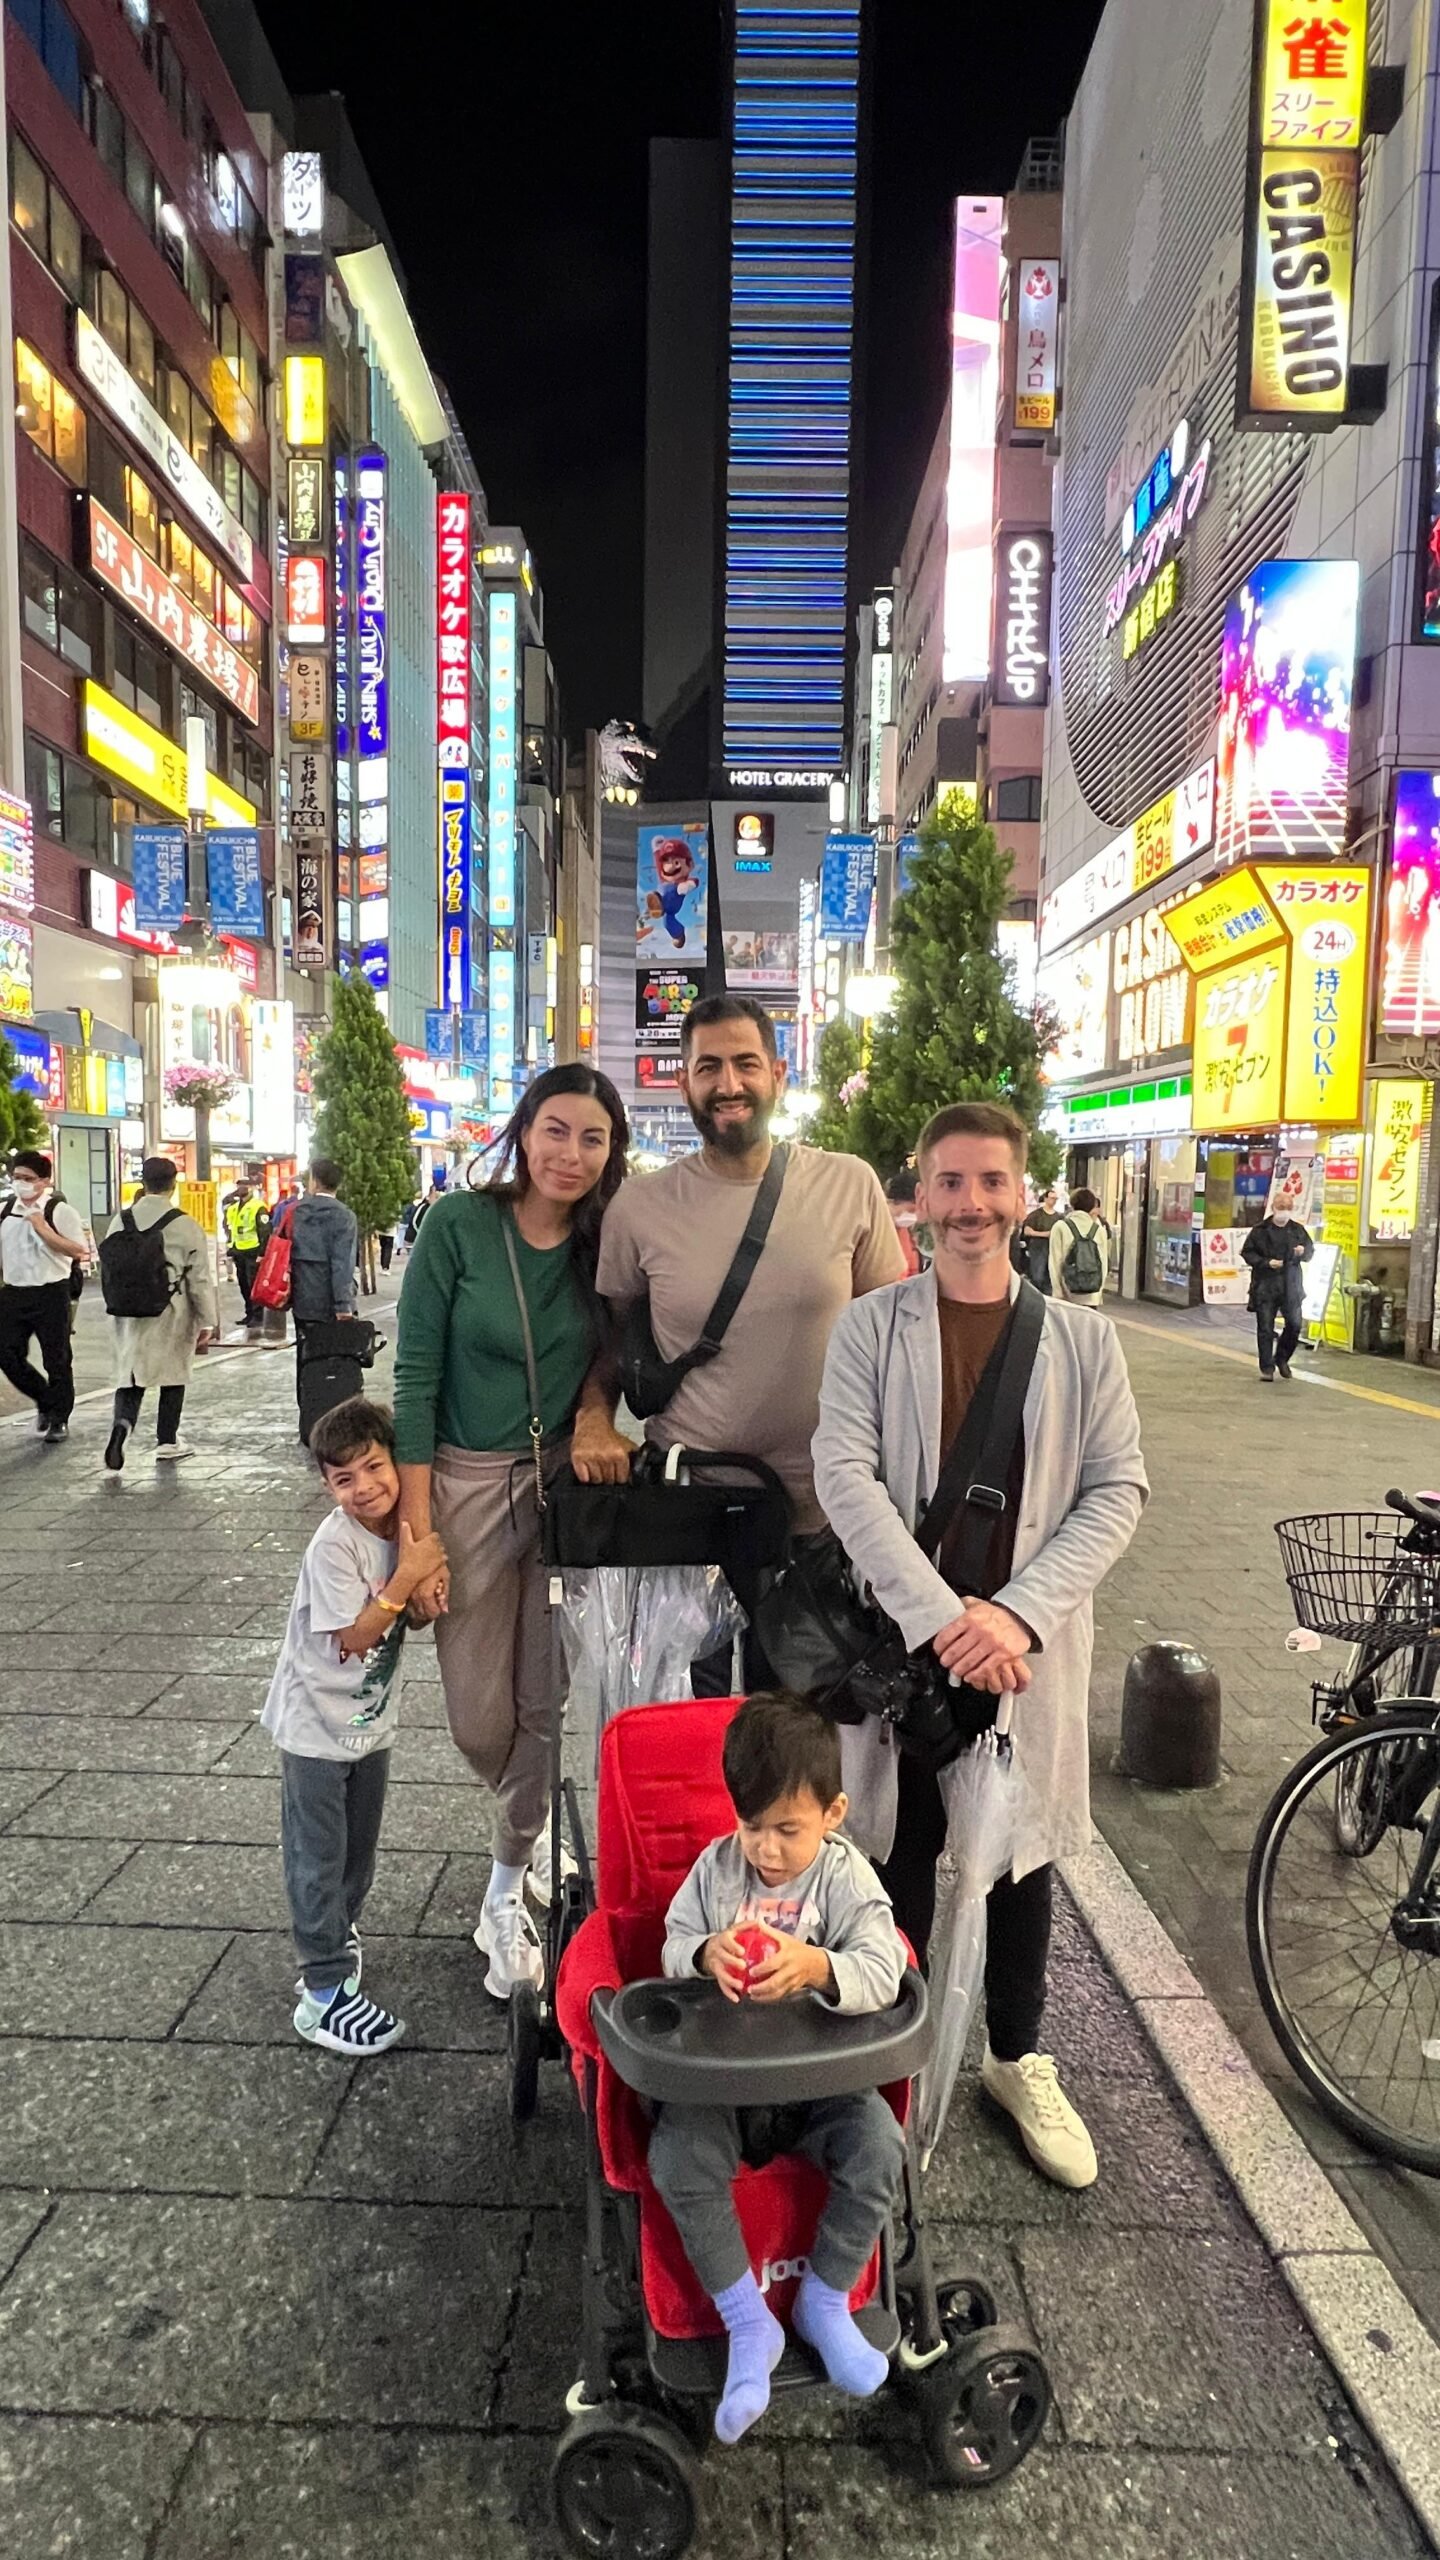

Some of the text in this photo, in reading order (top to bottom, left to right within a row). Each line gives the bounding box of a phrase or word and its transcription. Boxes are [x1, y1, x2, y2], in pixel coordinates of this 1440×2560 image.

[1270, 92, 1335, 112] スリー
[1268, 118, 1356, 141] ファイブ
[291, 156, 315, 221] ダーツ
[1262, 168, 1343, 396] CASINO
[1026, 329, 1047, 388] 鳥メロ
[1022, 406, 1050, 420] 199
[95, 518, 119, 569] 5F
[440, 502, 467, 730] カラオケ歌広場
[360, 628, 385, 724] SHINJUKU
[299, 722, 318, 736] 3F
[730, 771, 833, 787] HOTEL GRACERY
[157, 843, 170, 911] FESTIVAL
[170, 844, 183, 881] BLUE
[232, 845, 247, 913] FESTIVAL
[245, 846, 259, 882] BLUE
[300, 857, 319, 908] 海の家
[735, 861, 772, 873] IMAX
[860, 853, 874, 891] BLUE
[844, 852, 860, 920] FESTIVAL
[1276, 880, 1365, 903] カラオケ
[1312, 930, 1347, 951] 24H
[659, 975, 688, 985] SUPER
[1203, 961, 1281, 1030] カラオケ
[1312, 966, 1341, 1103] 持込OK!
